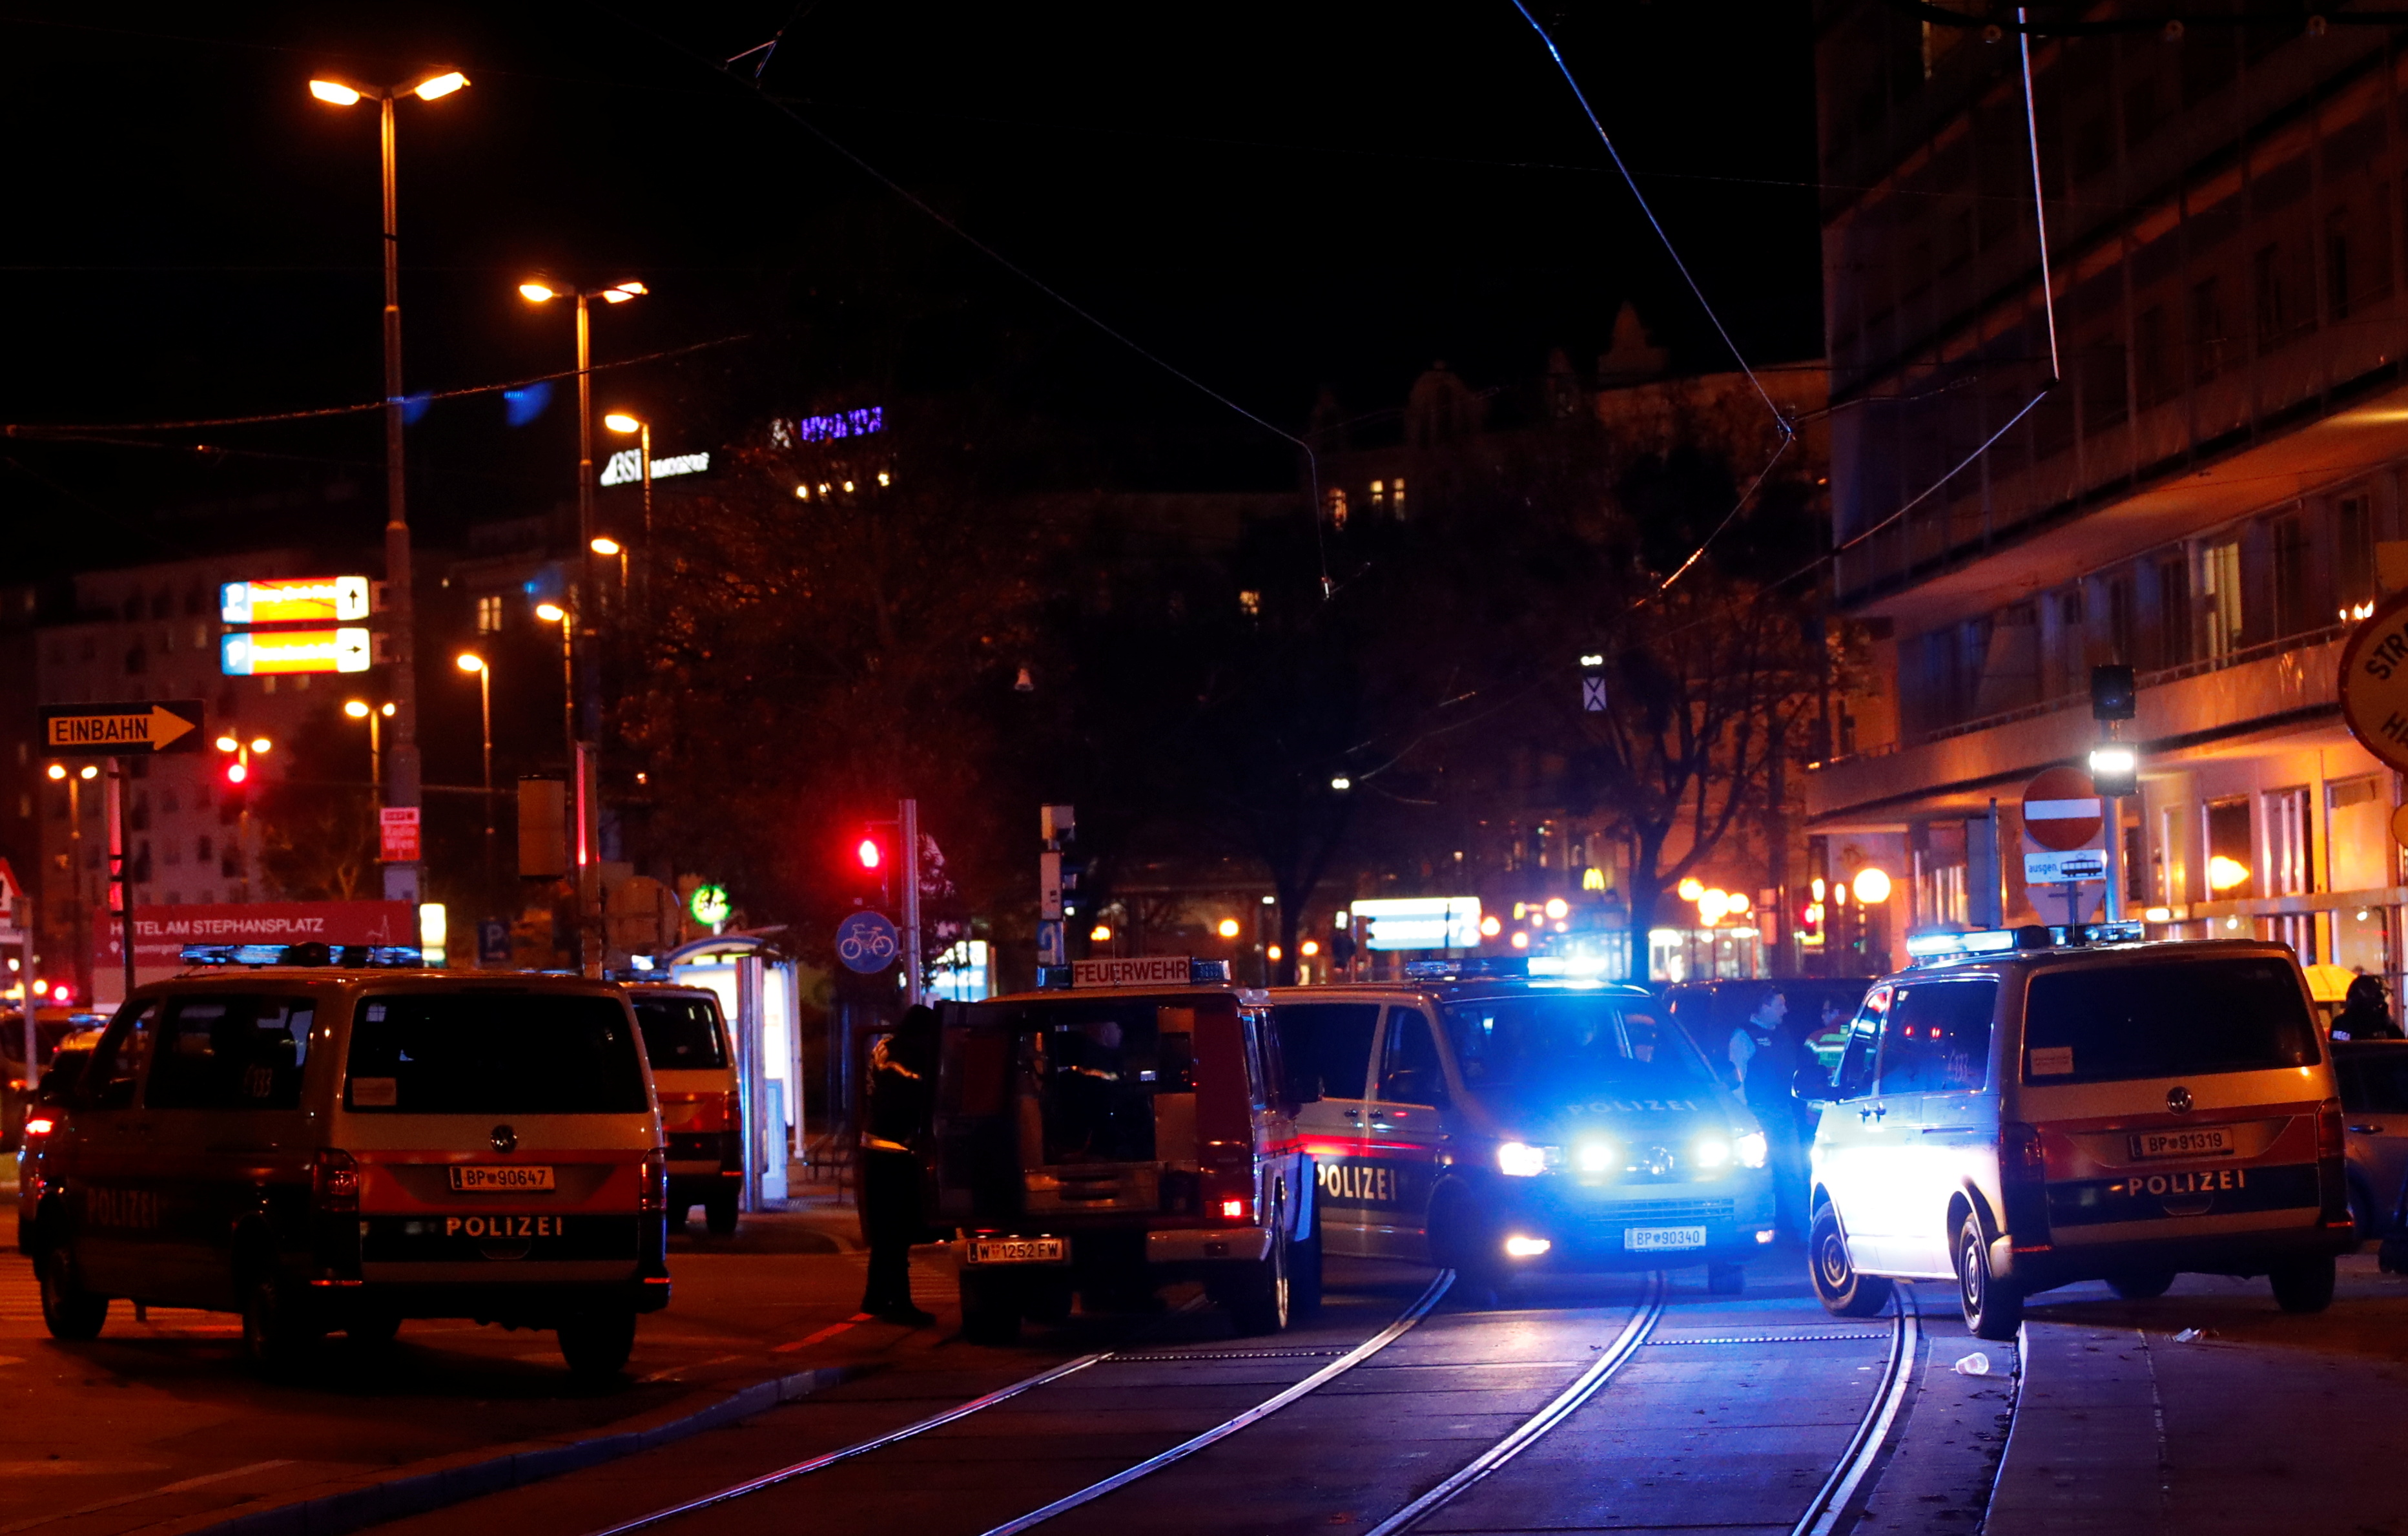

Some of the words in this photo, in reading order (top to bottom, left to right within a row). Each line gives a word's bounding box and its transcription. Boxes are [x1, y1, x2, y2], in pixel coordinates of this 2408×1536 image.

[2365, 622, 2408, 680] STR
[56, 718, 148, 742] EINBAHN
[110, 920, 163, 935] HTEL
[165, 920, 189, 934] AM
[194, 917, 324, 934] STEPHANSPLATZ
[1075, 960, 1188, 982] FEUERWEHR
[1568, 1100, 1698, 1115] POLIZEI
[2149, 1137, 2167, 1152] BP
[2179, 1132, 2222, 1149] 91319
[467, 1170, 485, 1185] BP
[498, 1170, 545, 1185] 90647
[2128, 1170, 2246, 1197] POLIZEI
[87, 1186, 158, 1229] POLIZEI
[446, 1216, 563, 1236] POLIZEI
[1637, 1232, 1651, 1245] BP
[1662, 1230, 1700, 1244] 90340
